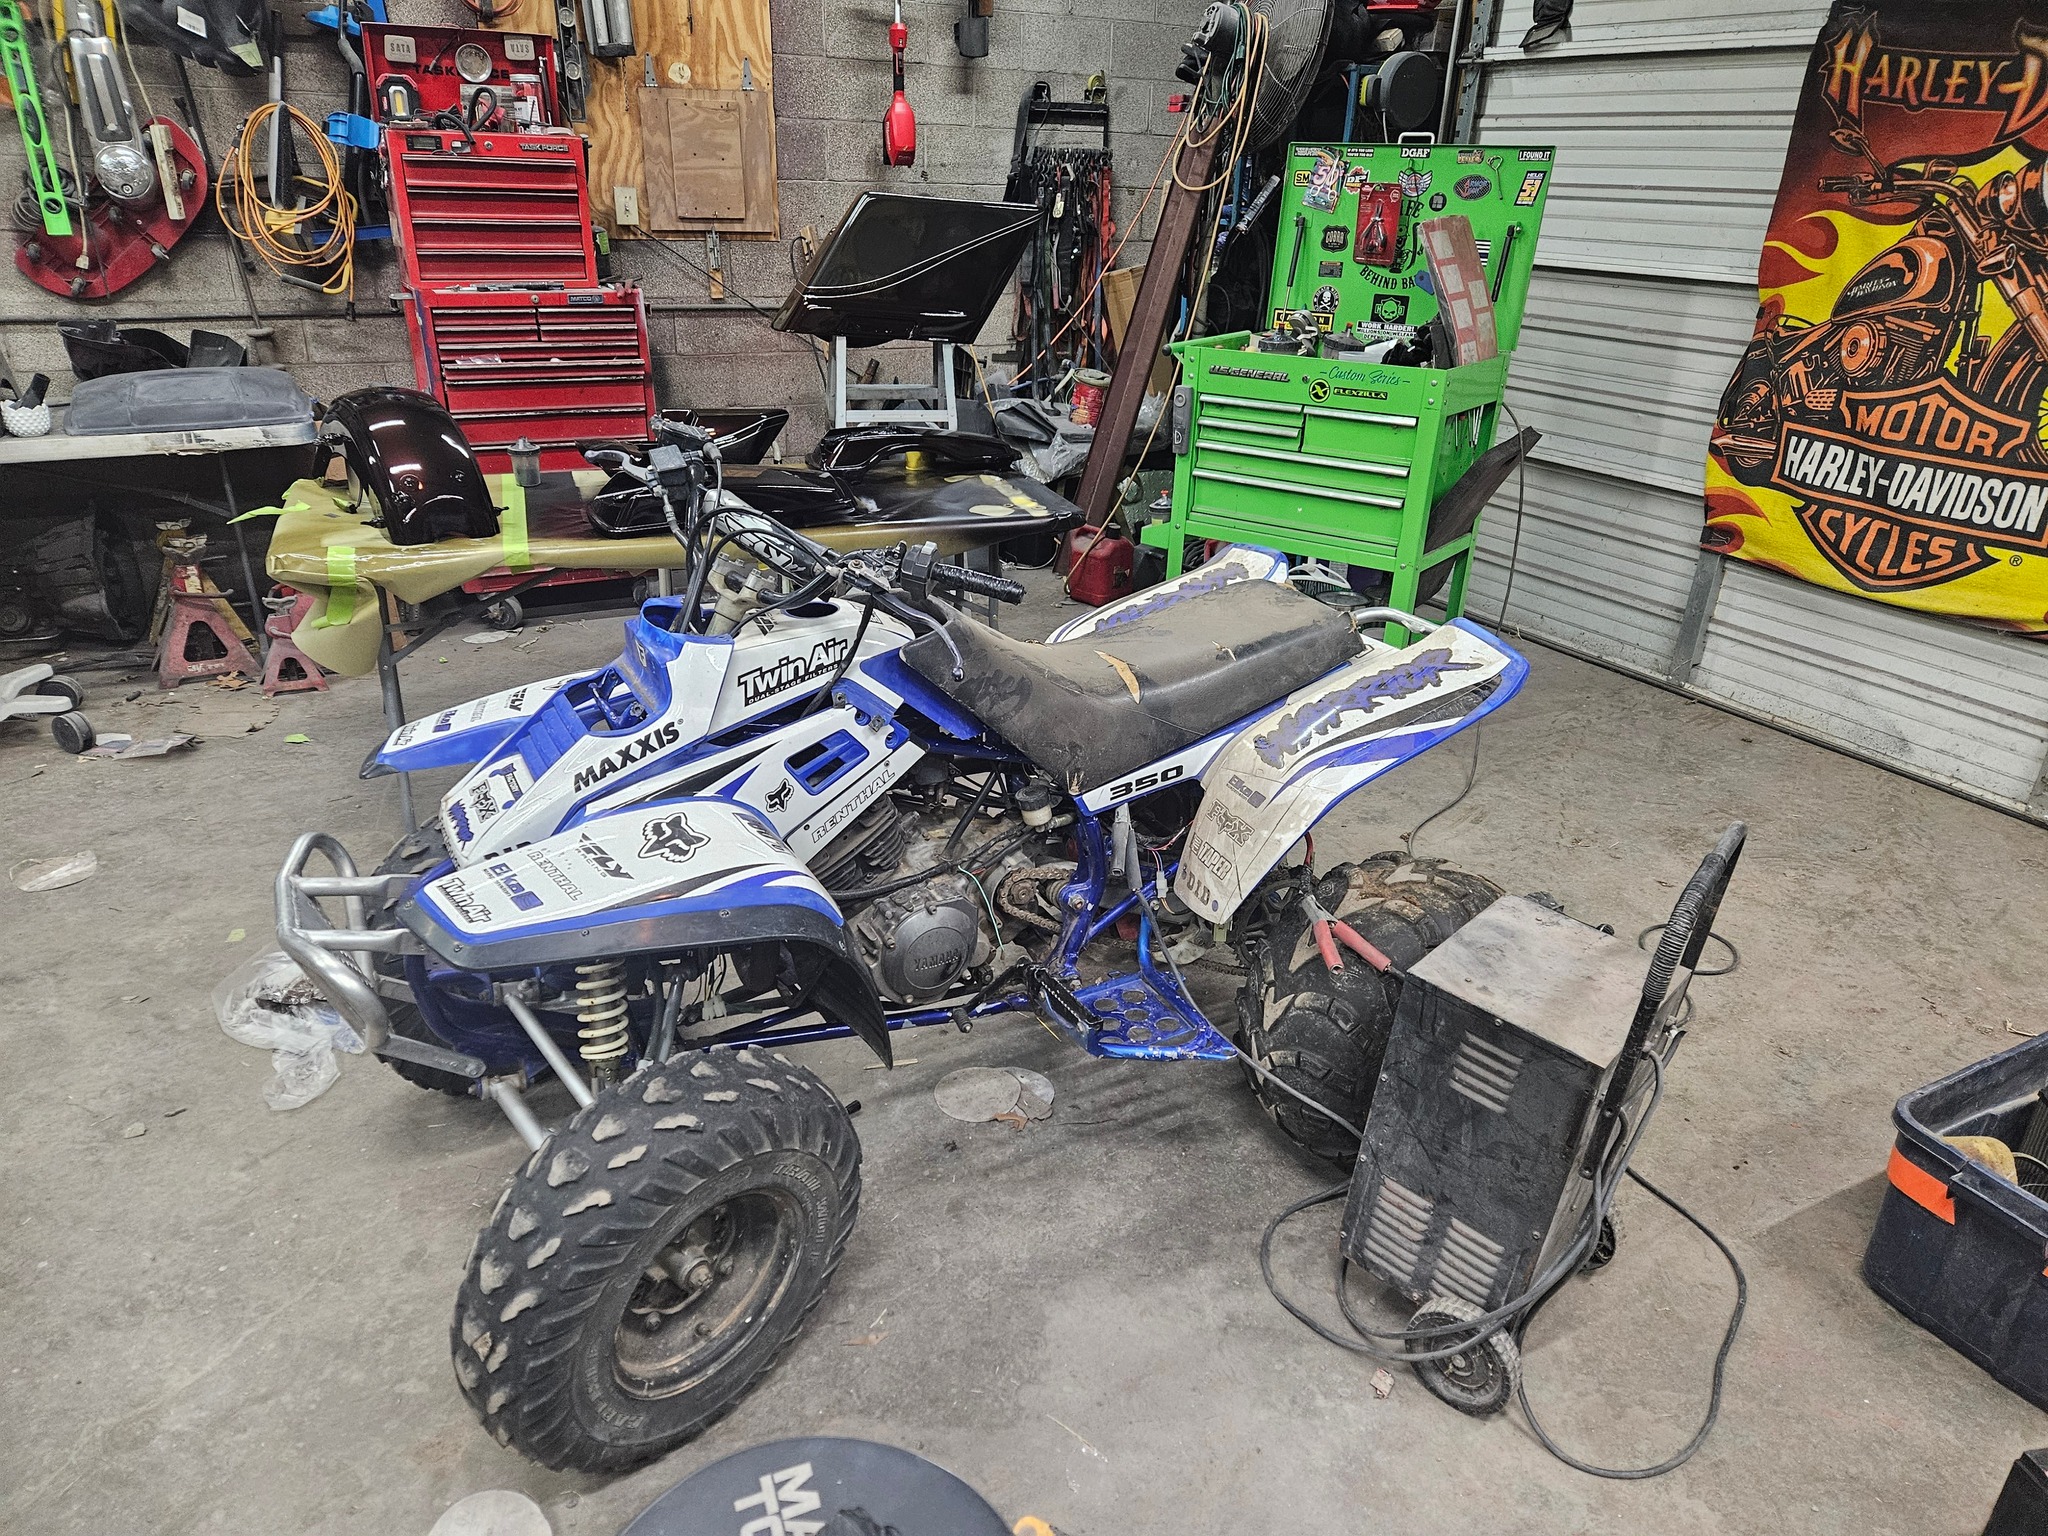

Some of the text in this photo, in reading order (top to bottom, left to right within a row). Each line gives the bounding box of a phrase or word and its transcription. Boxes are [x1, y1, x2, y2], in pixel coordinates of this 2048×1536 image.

[390, 42, 411, 54] SATA
[520, 143, 569, 152] TASK FORCE
[1401, 148, 1430, 158] DGAF
[1360, 265, 1397, 290] BEHIND
[1384, 323, 1415, 332] HARDER!
[1328, 366, 1401, 386] Custom Series
[1334, 388, 1387, 400] FLEXZILLA
[1855, 392, 1999, 457] MOTOR
[1784, 435, 2048, 533] HARLEY-DAVIDSON
[1818, 504, 1957, 576] CYCLES
[748, 664, 838, 704] DUAL-STAGE FILTERS
[573, 721, 680, 793] MAXXIS
[1109, 764, 1184, 801] 350
[811, 769, 896, 844] RENTHAL
[527, 850, 584, 902] RENTHAL
[575, 847, 608, 878] RACING
[1197, 841, 1233, 881] TAPER
[914, 948, 959, 972] YAMAHA
